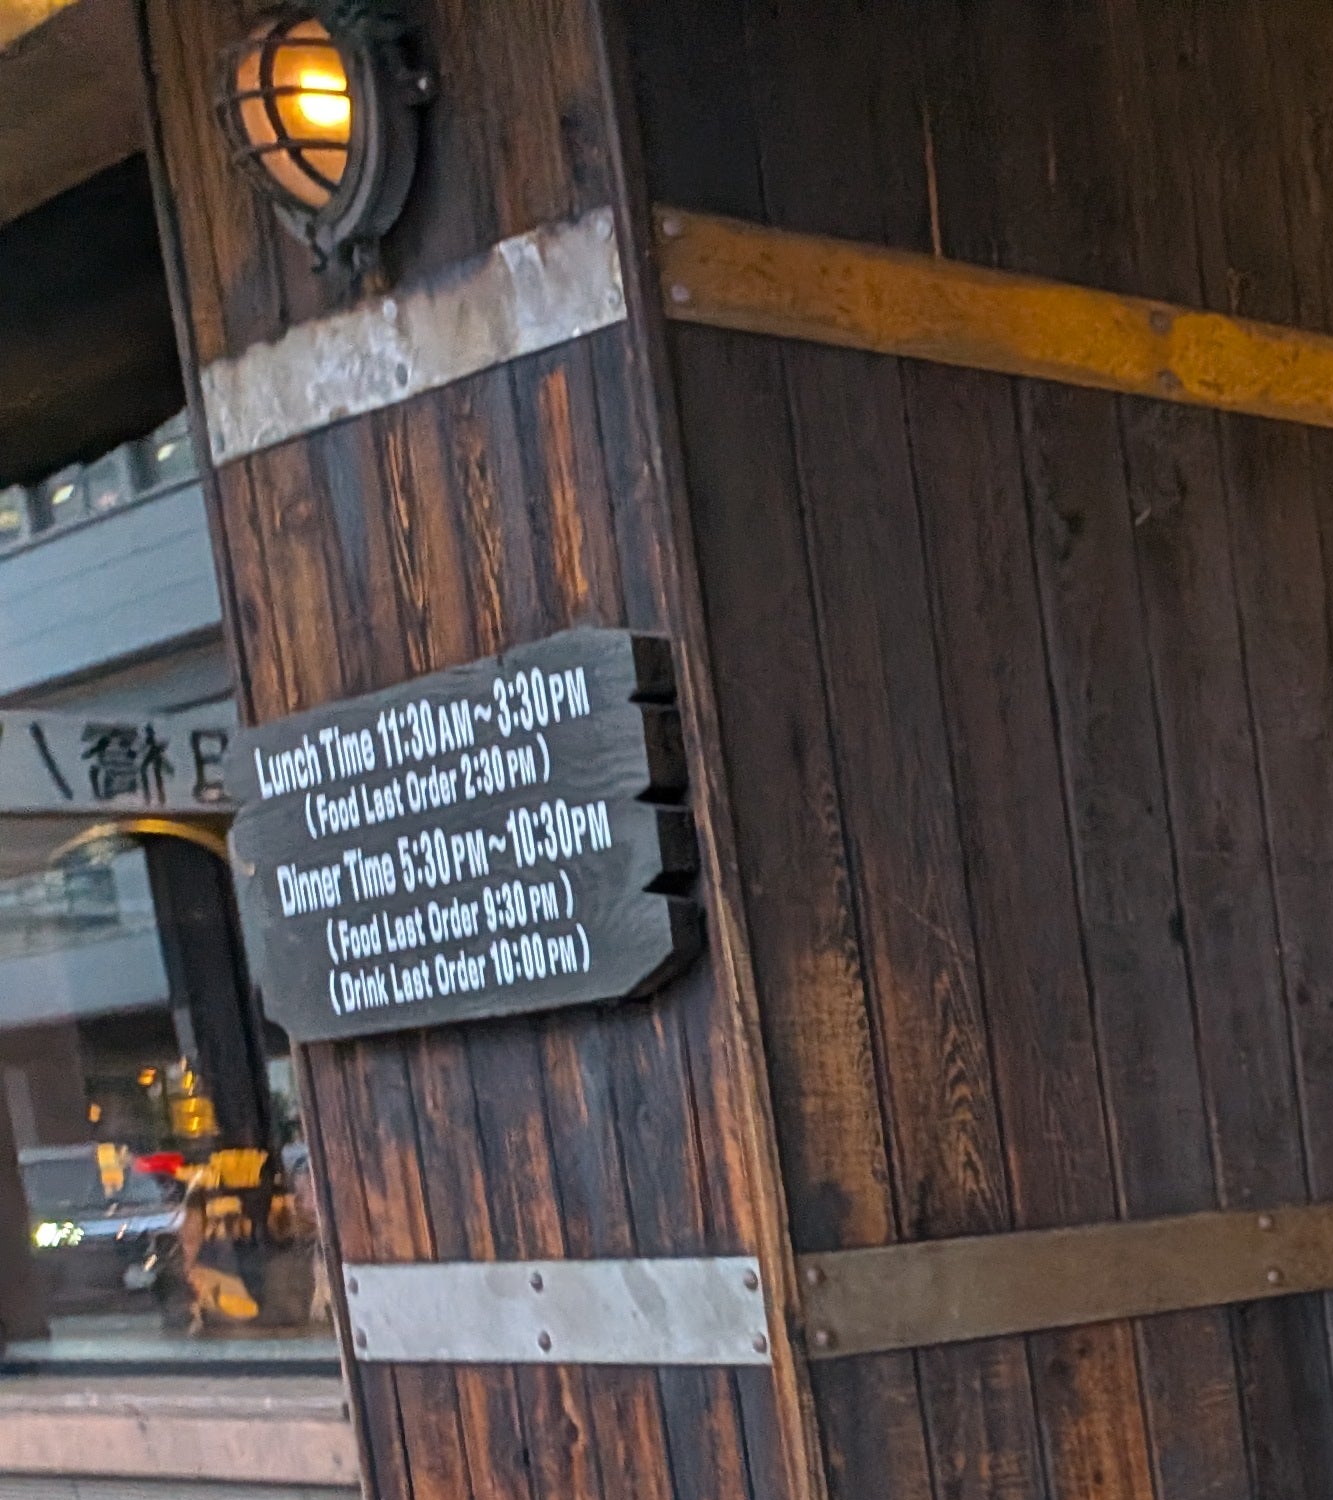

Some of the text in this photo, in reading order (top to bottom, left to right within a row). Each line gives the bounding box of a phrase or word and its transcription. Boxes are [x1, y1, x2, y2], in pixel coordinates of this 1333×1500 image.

[255, 734, 322, 799] Lunch
[319, 726, 376, 781] Time
[361, 777, 405, 825] Last
[406, 765, 457, 814] Order
[276, 861, 341, 917] Dinner
[343, 847, 397, 902] Time
[383, 907, 427, 952] Last
[427, 897, 480, 944] Order
[390, 958, 434, 1004] Last
[434, 950, 486, 997] Order
